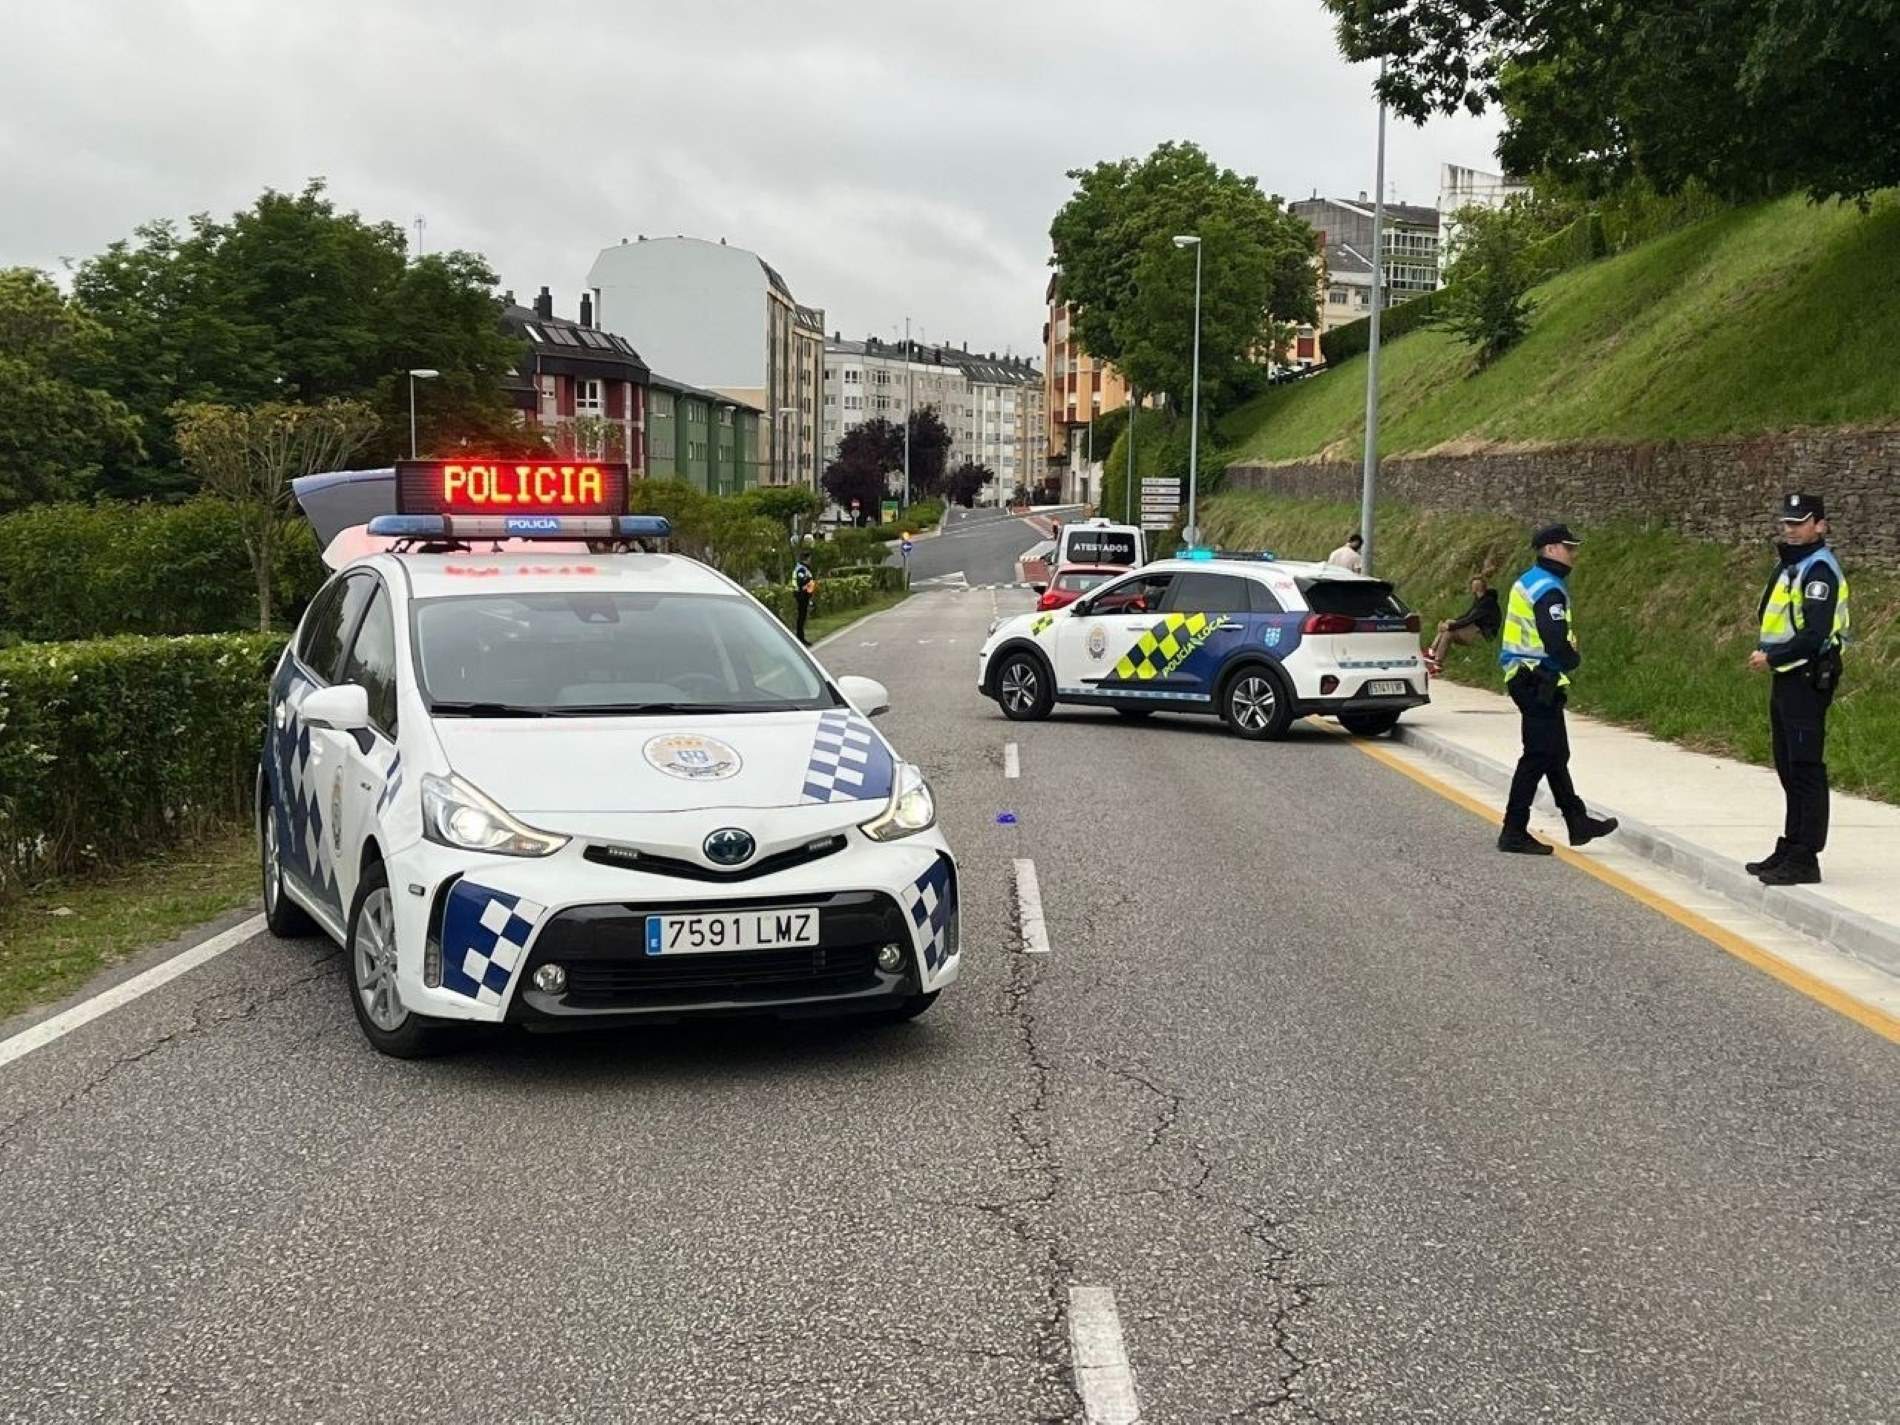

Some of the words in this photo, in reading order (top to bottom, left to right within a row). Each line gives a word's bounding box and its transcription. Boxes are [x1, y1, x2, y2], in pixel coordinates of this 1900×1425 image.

[444, 465, 603, 504] POLICIA
[1073, 542, 1129, 553] ATESTADOS
[1197, 614, 1233, 641] LOCAL
[669, 918, 741, 948] 7591
[756, 914, 811, 944] LMZ
